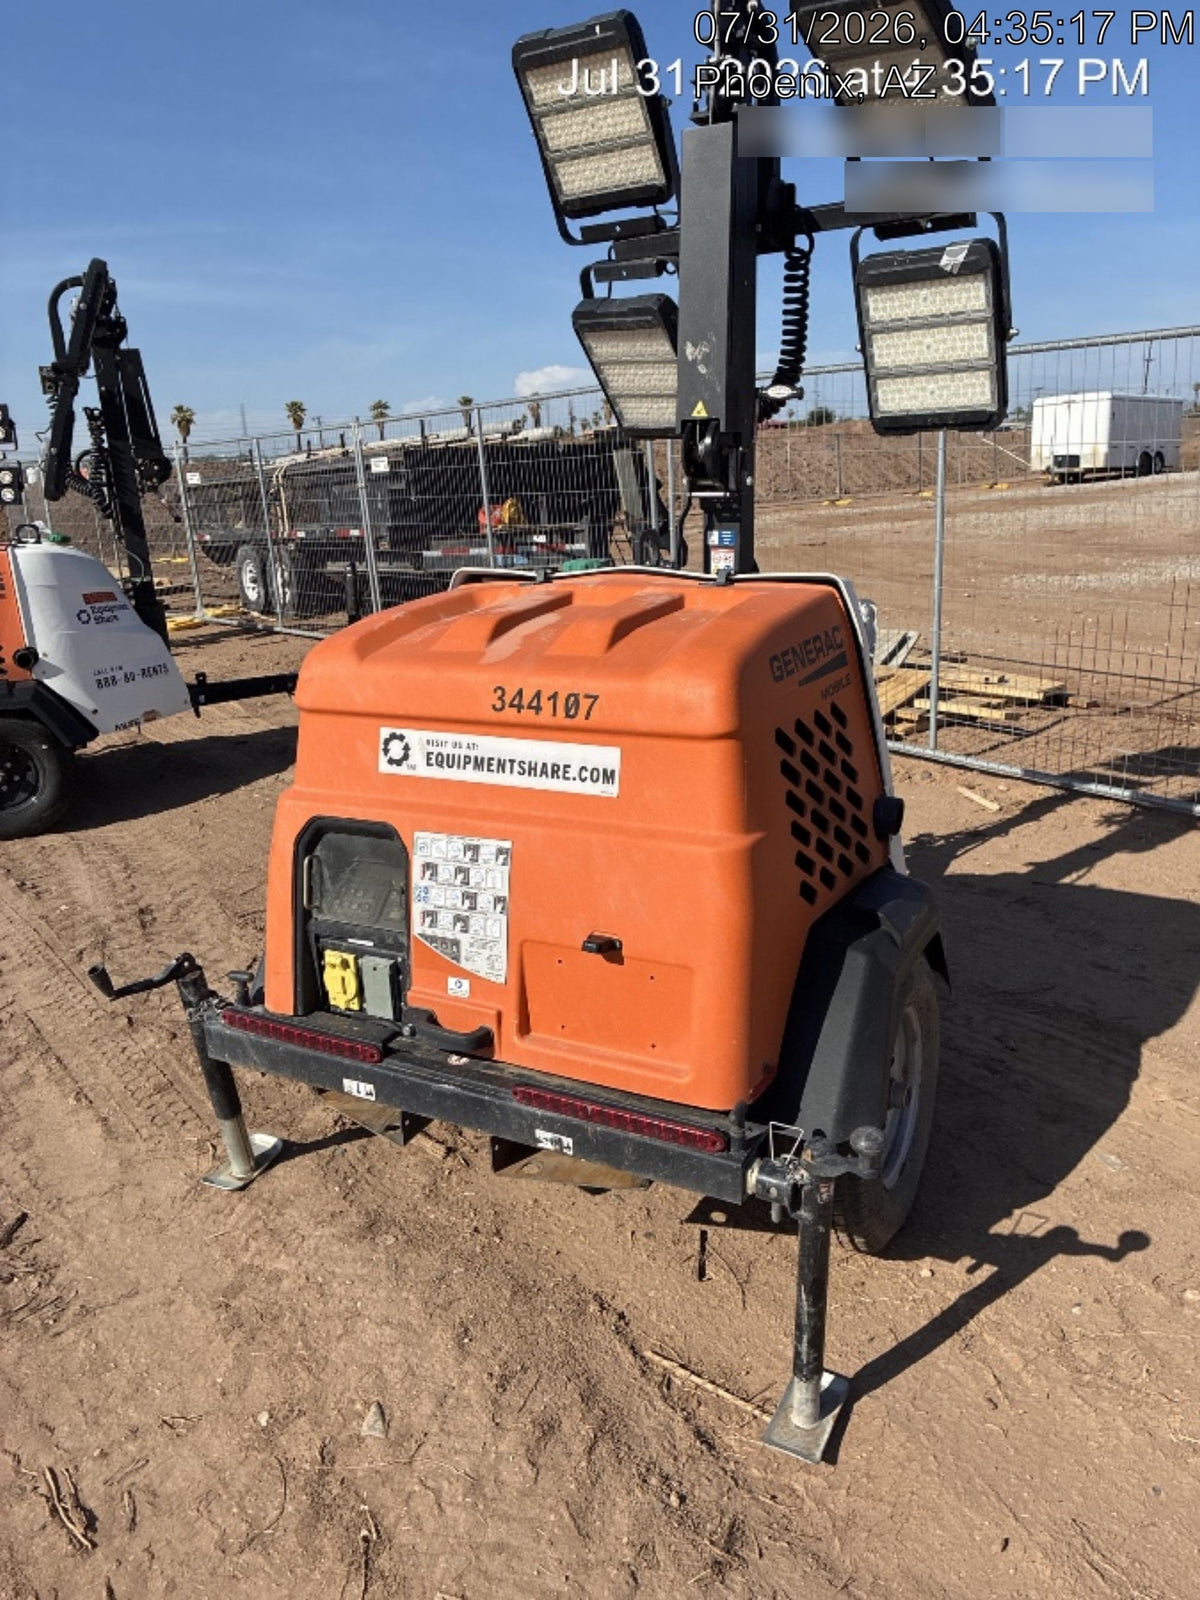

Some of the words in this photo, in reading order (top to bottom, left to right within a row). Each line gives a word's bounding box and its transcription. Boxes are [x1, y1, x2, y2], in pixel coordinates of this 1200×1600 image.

[768, 624, 844, 684] GENERAC
[491, 683, 600, 721] 344107
[425, 751, 616, 785] EQUIPMENTSHARE.COM
